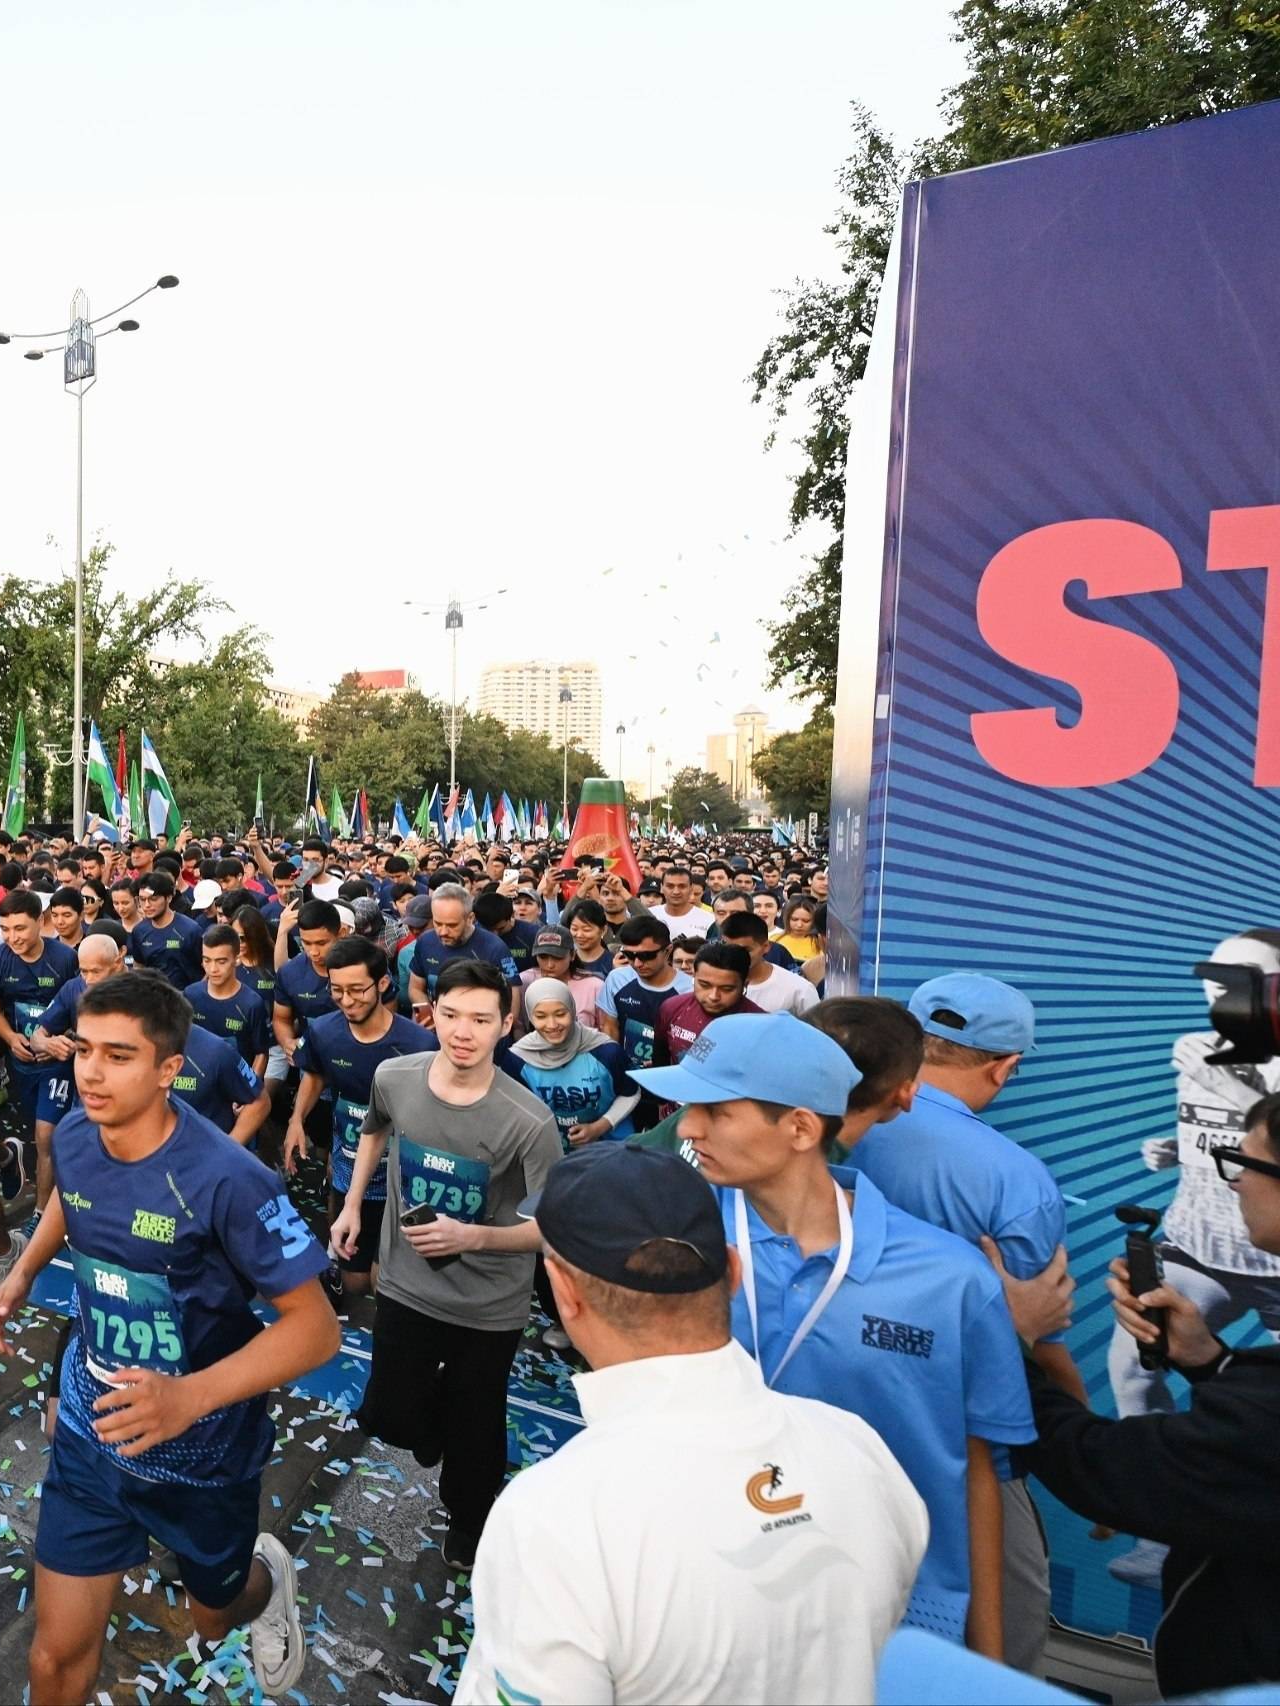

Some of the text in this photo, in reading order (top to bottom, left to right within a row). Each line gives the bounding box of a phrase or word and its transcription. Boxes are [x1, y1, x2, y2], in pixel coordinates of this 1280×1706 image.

[49, 1078, 70, 1103] 14
[536, 1085, 602, 1104] TASH
[411, 1175, 483, 1216] 8739
[90, 1306, 183, 1362] 7295
[862, 1315, 923, 1342] TASH
